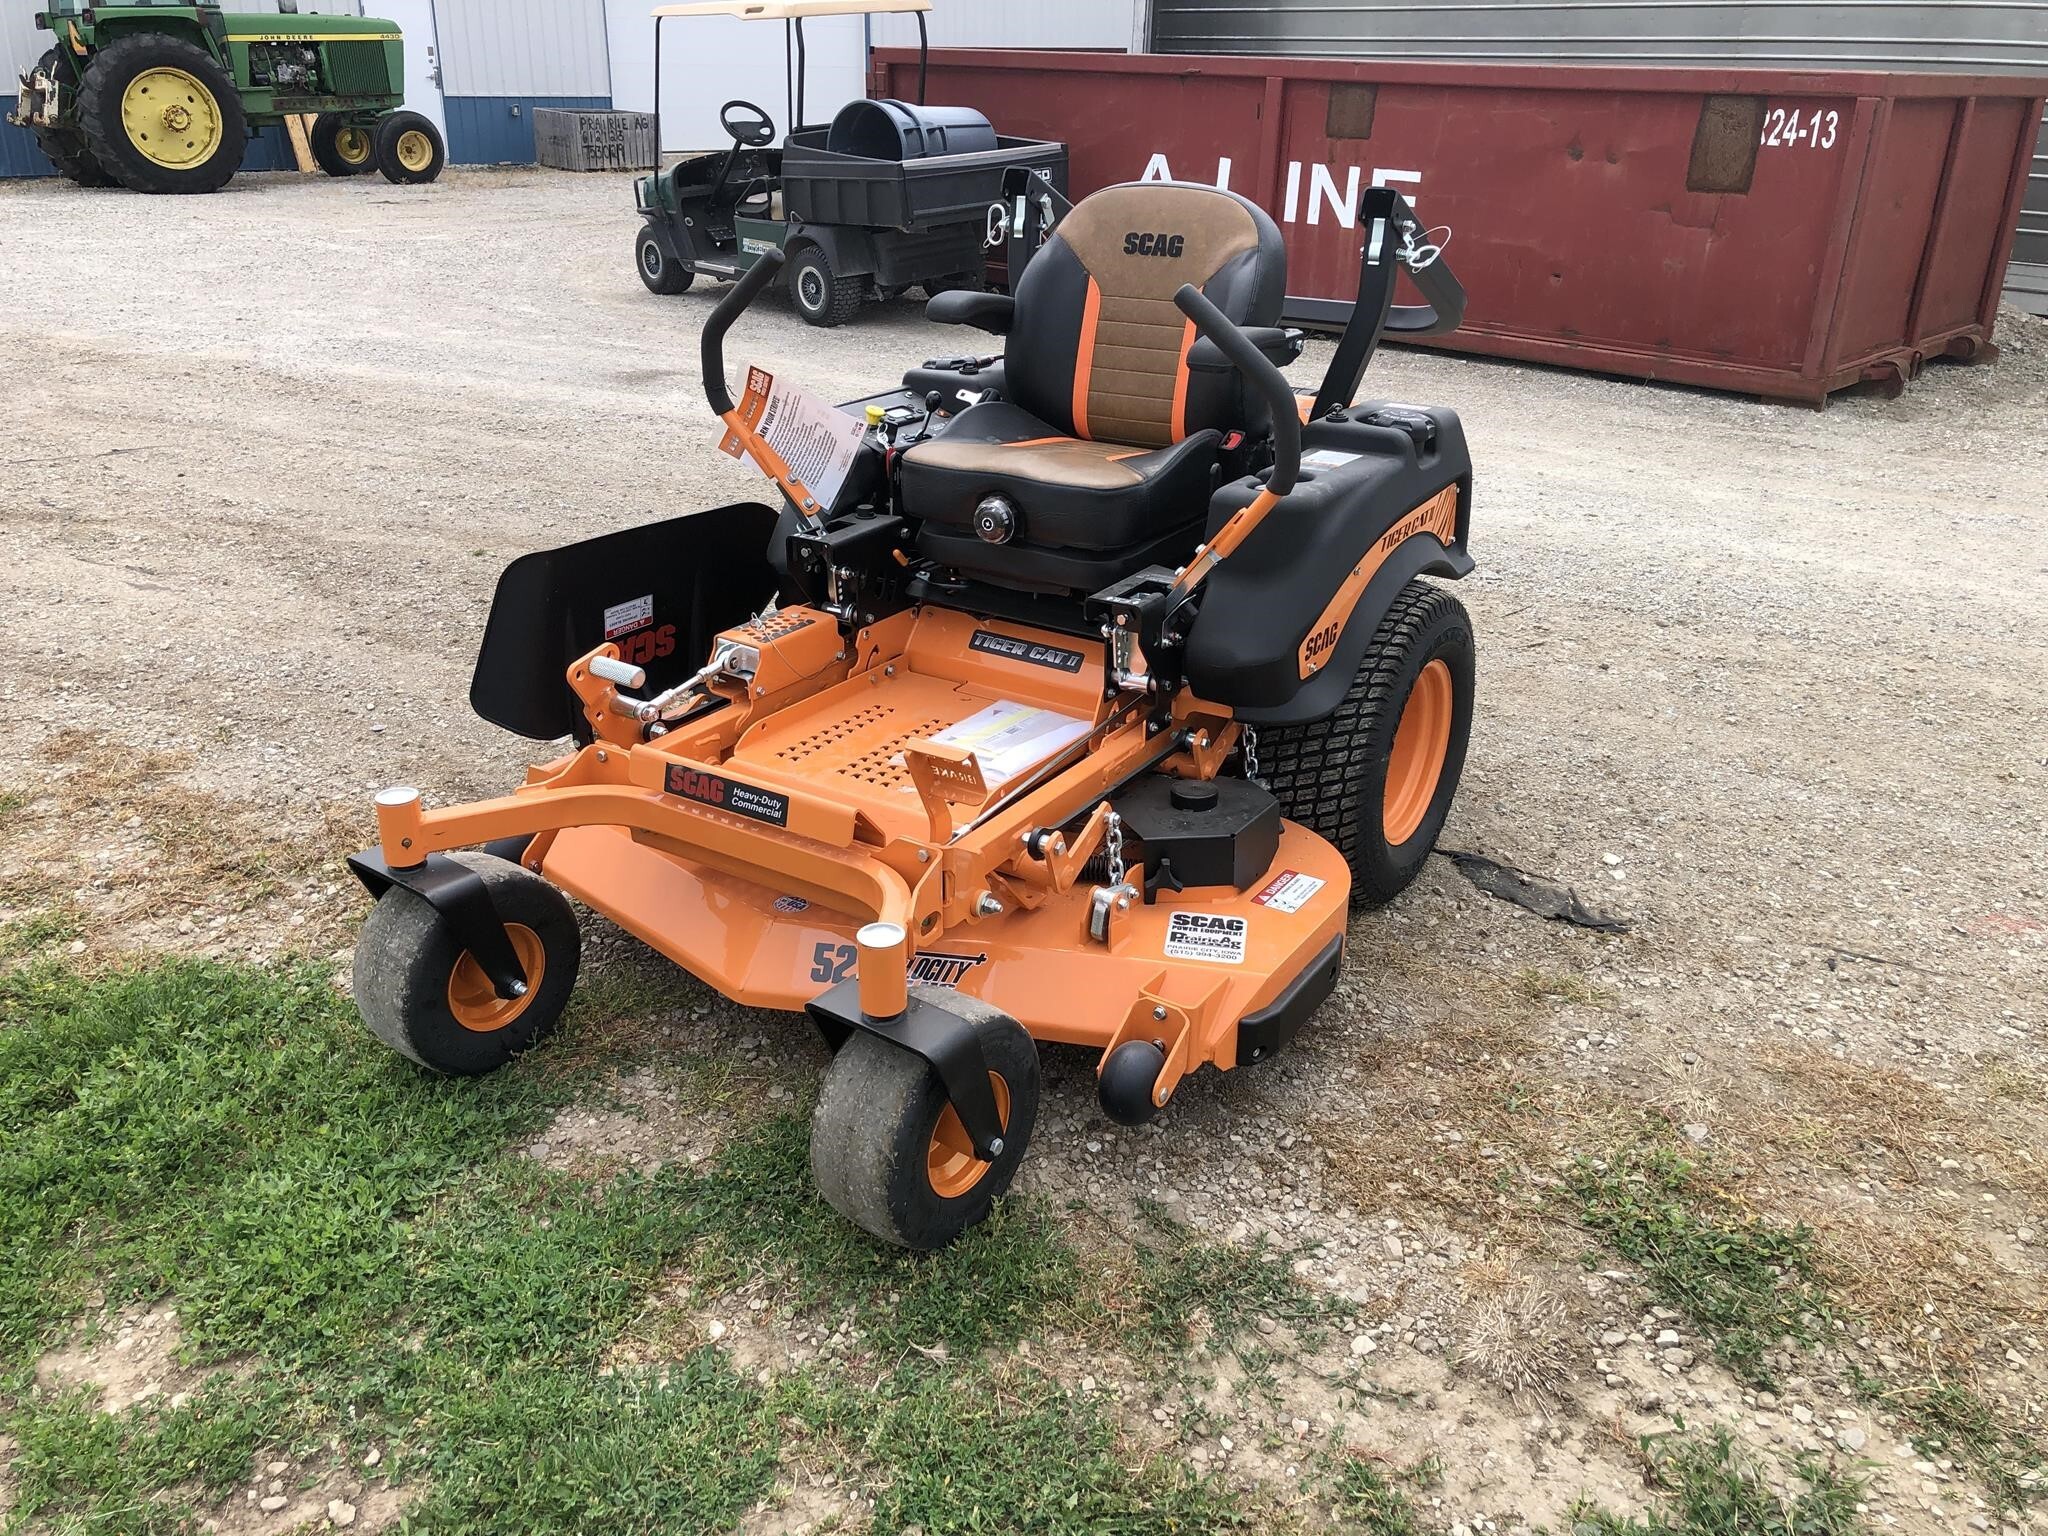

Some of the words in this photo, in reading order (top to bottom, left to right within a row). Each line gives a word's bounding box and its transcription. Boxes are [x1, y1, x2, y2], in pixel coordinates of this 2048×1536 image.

[580, 117, 628, 131] PRAIRIE
[635, 117, 649, 130] AG
[1761, 108, 1839, 149] 24-13
[1123, 232, 1184, 258] SCAG
[750, 369, 765, 394] SCAG
[1380, 521, 1412, 553] TIGER
[1410, 510, 1429, 533] CAT
[616, 624, 677, 665] SCA
[974, 633, 1028, 656] TIGER
[1028, 646, 1069, 664] CAT
[1304, 622, 1338, 662] SCAG
[669, 765, 725, 803] SCAG
[731, 797, 782, 819] Commercial
[732, 787, 782, 810] Heavy-Duty
[1266, 873, 1294, 895] DANGER
[1172, 913, 1244, 931] SCAG
[1200, 928, 1242, 936] EQUIPMENT
[811, 943, 858, 983] 52
[906, 956, 973, 984] LOCITY
